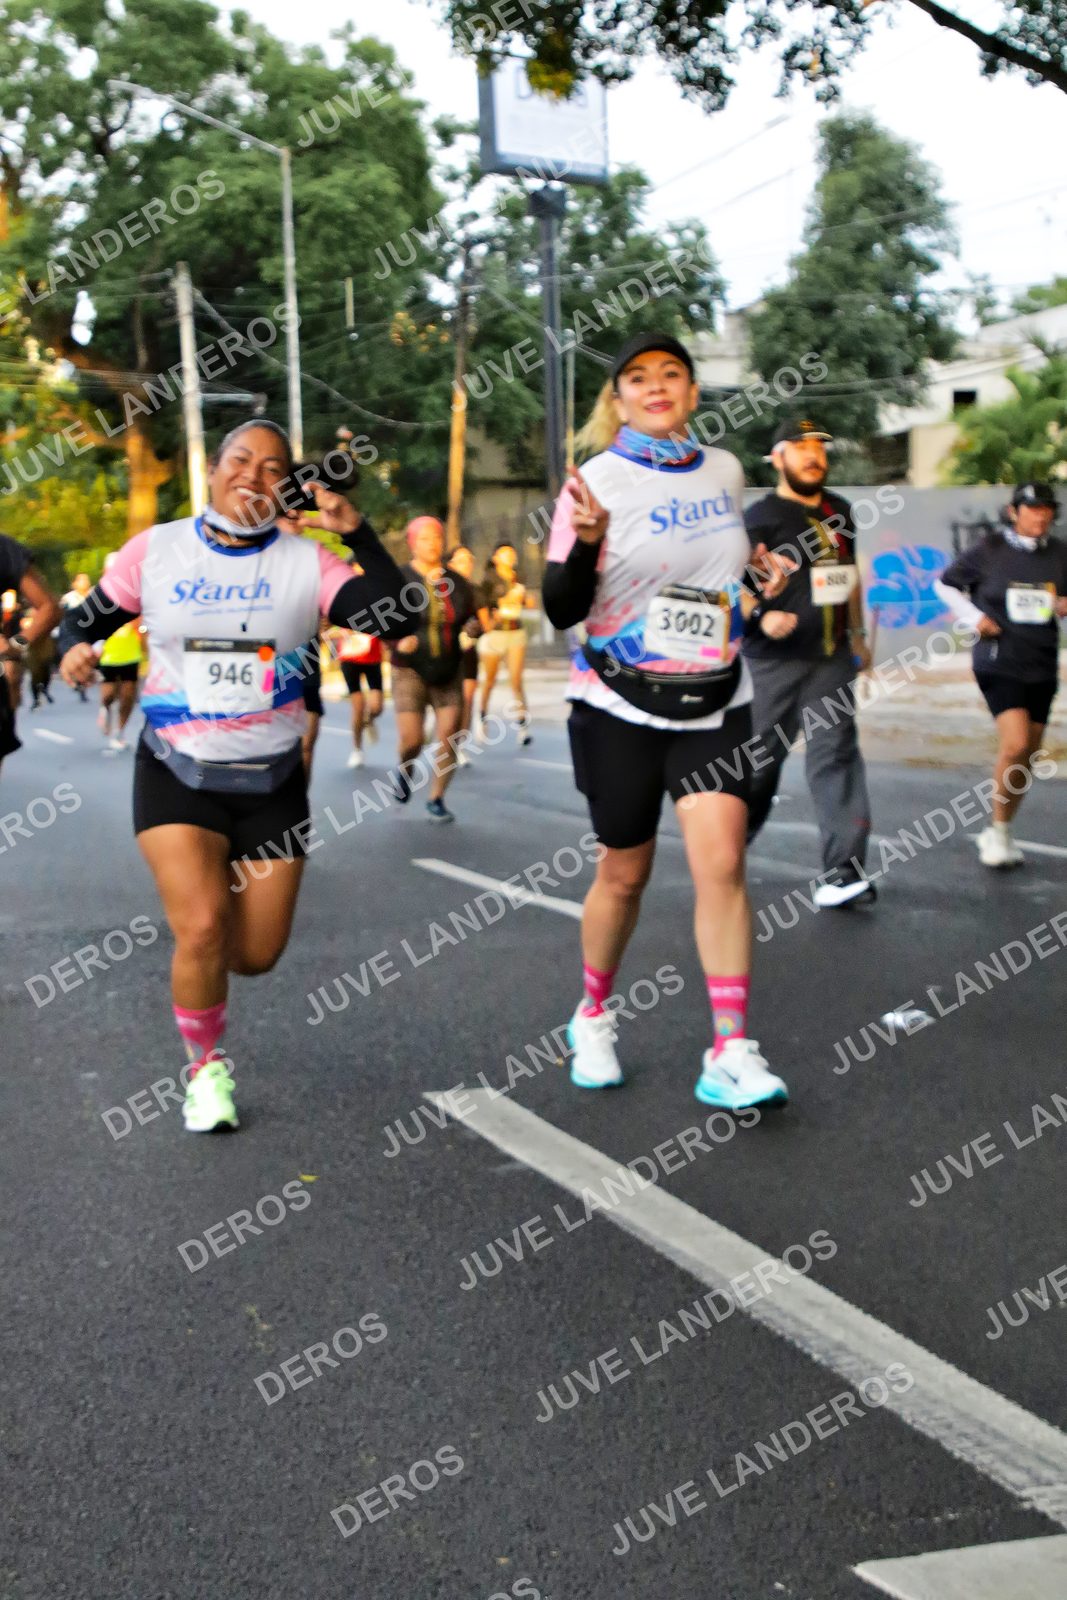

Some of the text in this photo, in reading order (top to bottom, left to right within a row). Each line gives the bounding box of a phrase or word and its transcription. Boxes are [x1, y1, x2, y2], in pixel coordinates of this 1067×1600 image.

[169, 577, 270, 605] Starch
[659, 607, 715, 637] 3002
[209, 662, 253, 686] 946
